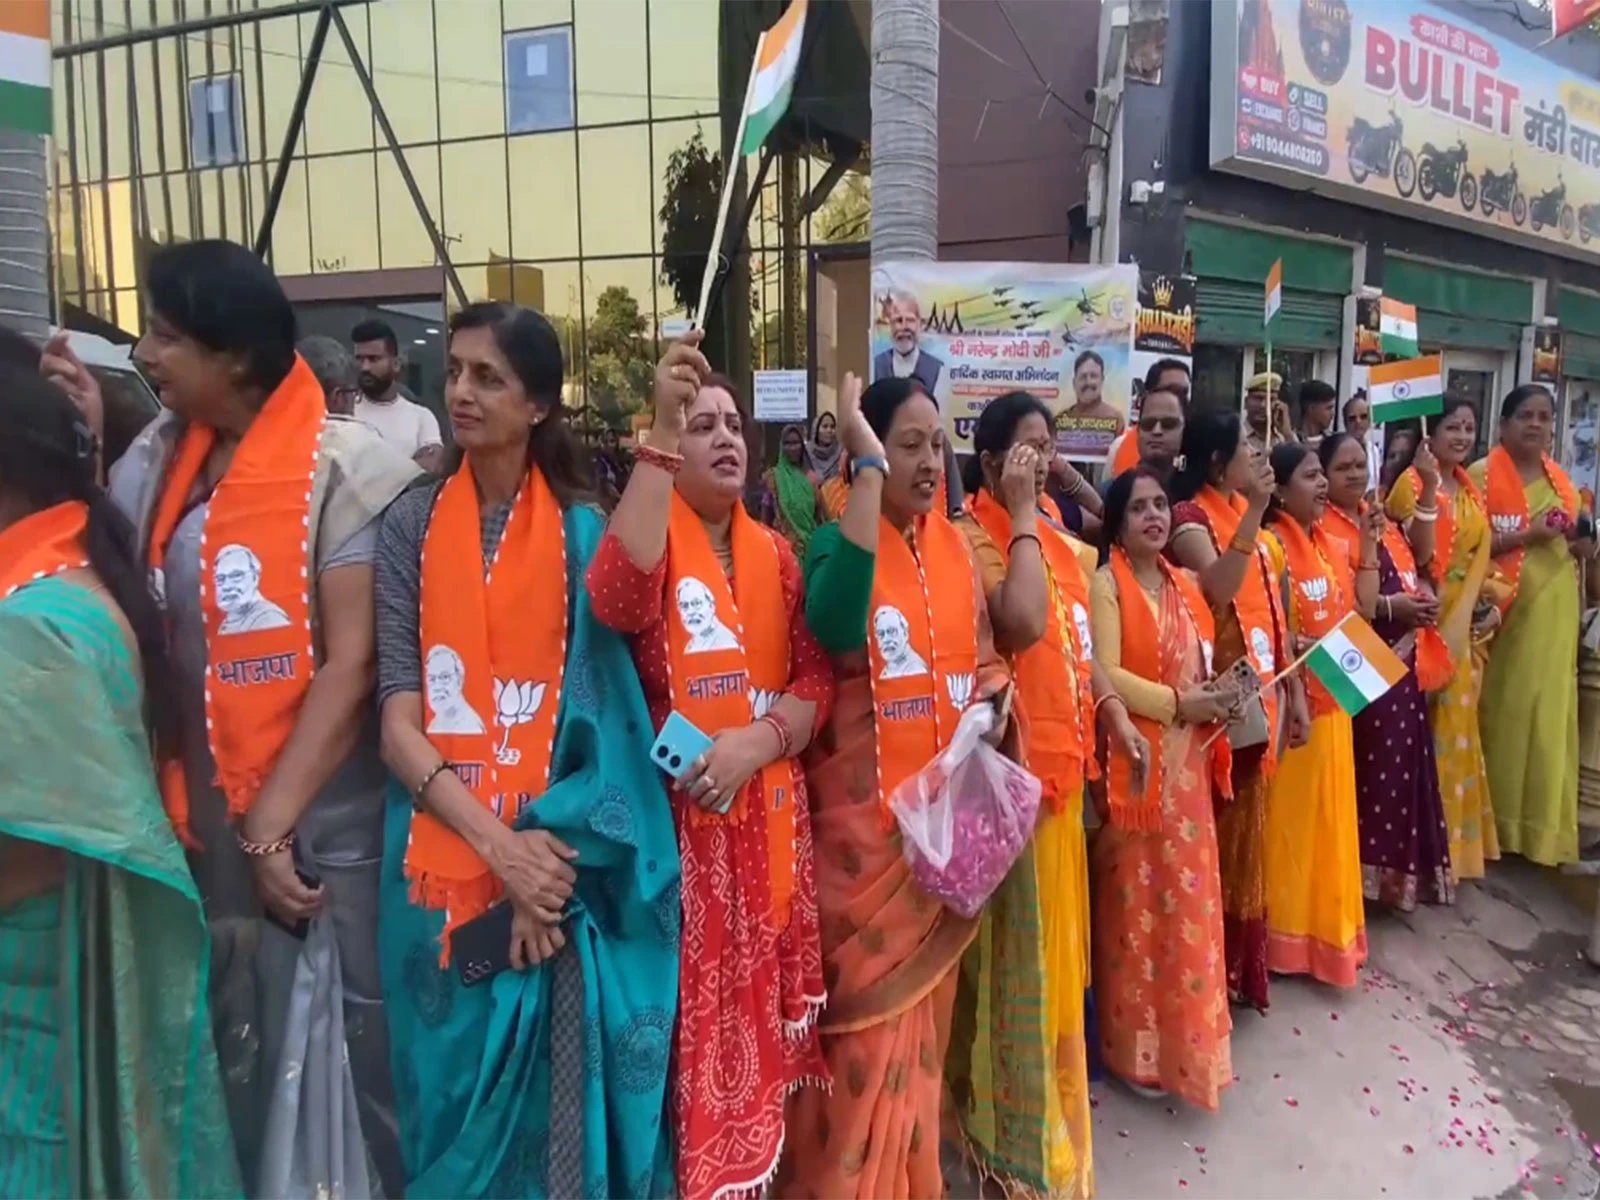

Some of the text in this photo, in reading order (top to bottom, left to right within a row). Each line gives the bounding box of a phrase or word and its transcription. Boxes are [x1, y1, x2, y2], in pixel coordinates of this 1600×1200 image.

[1260, 76, 1280, 96] BUY
[1364, 25, 1520, 136] BULLET
[1303, 91, 1325, 111] SELL
[1523, 98, 1567, 155] मंडी
[949, 340, 965, 358] श्री
[967, 340, 999, 359] नरेन्द्र
[1002, 340, 1030, 359] मोदी
[1033, 340, 1050, 359] जी
[949, 363, 979, 380] हार्दिक
[981, 367, 1014, 381] स्वागत
[217, 652, 298, 686] भाजपा
[687, 671, 748, 700] भाजपा
[881, 696, 932, 721] भाजपा
